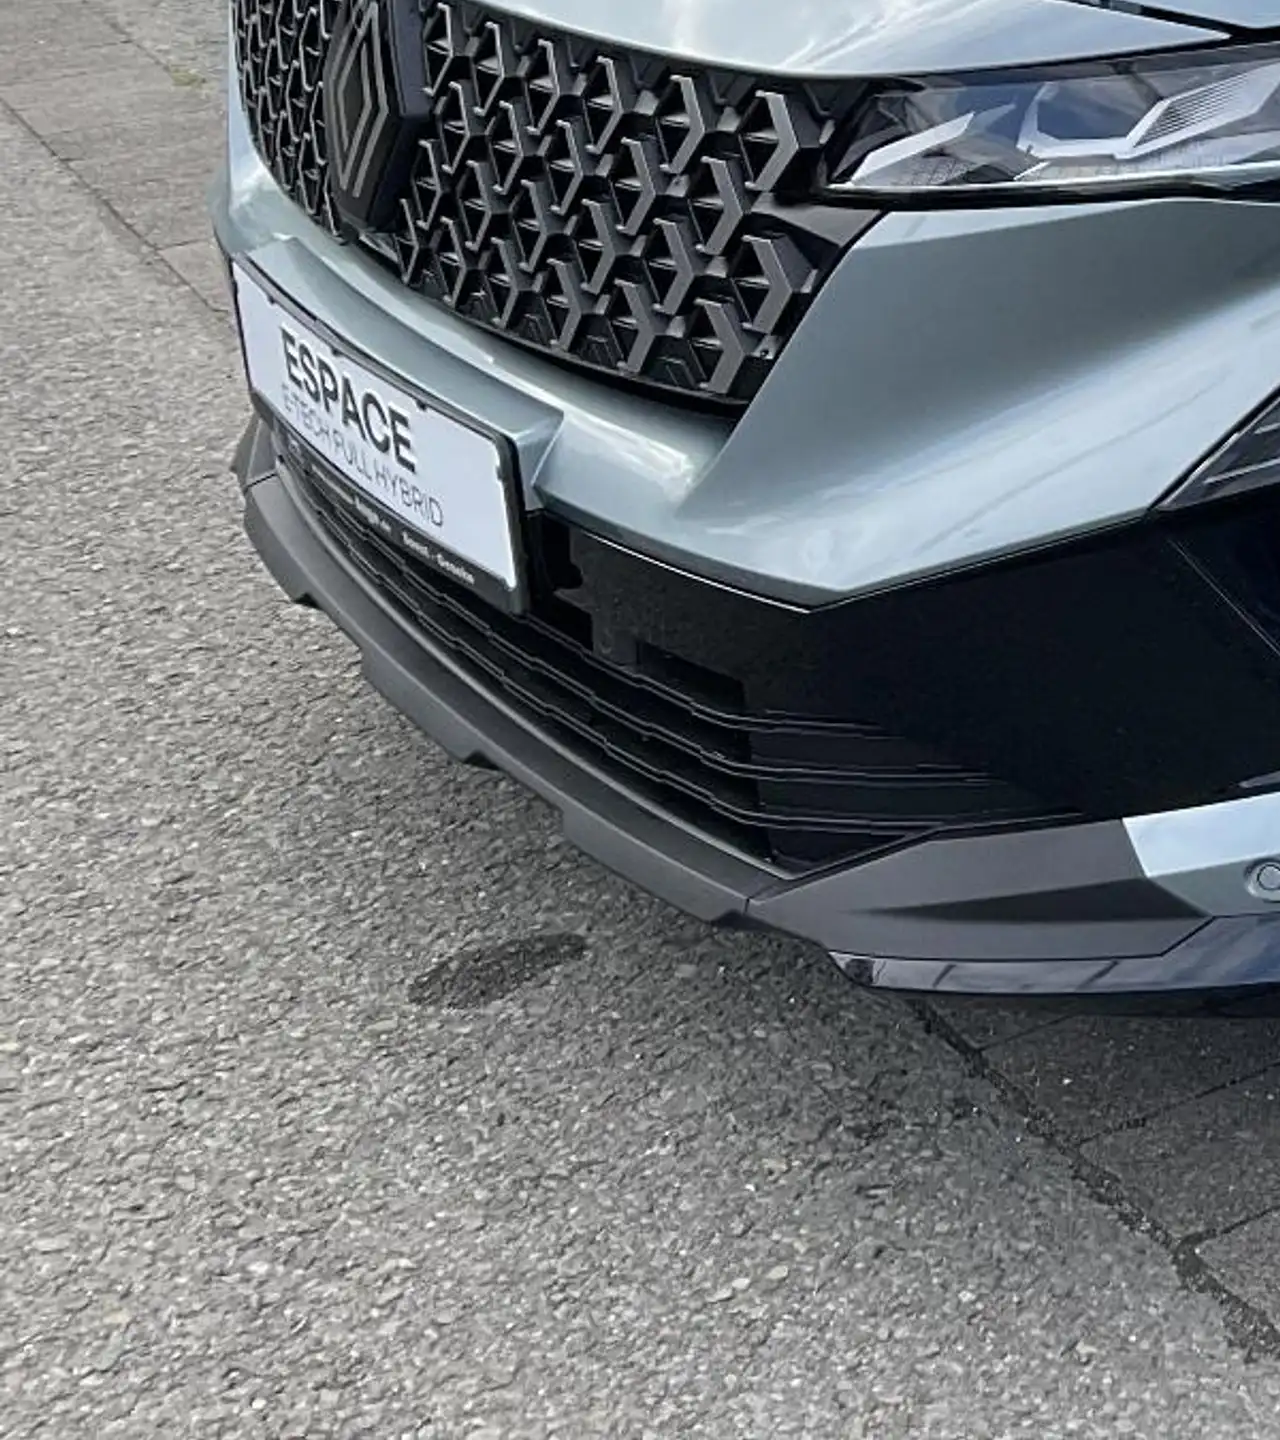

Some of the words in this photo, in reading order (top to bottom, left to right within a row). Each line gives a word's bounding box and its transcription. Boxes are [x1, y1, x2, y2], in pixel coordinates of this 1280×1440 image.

[281, 325, 417, 474] ESPACE
[333, 427, 373, 481] FULL
[373, 457, 444, 528] HYBRID
